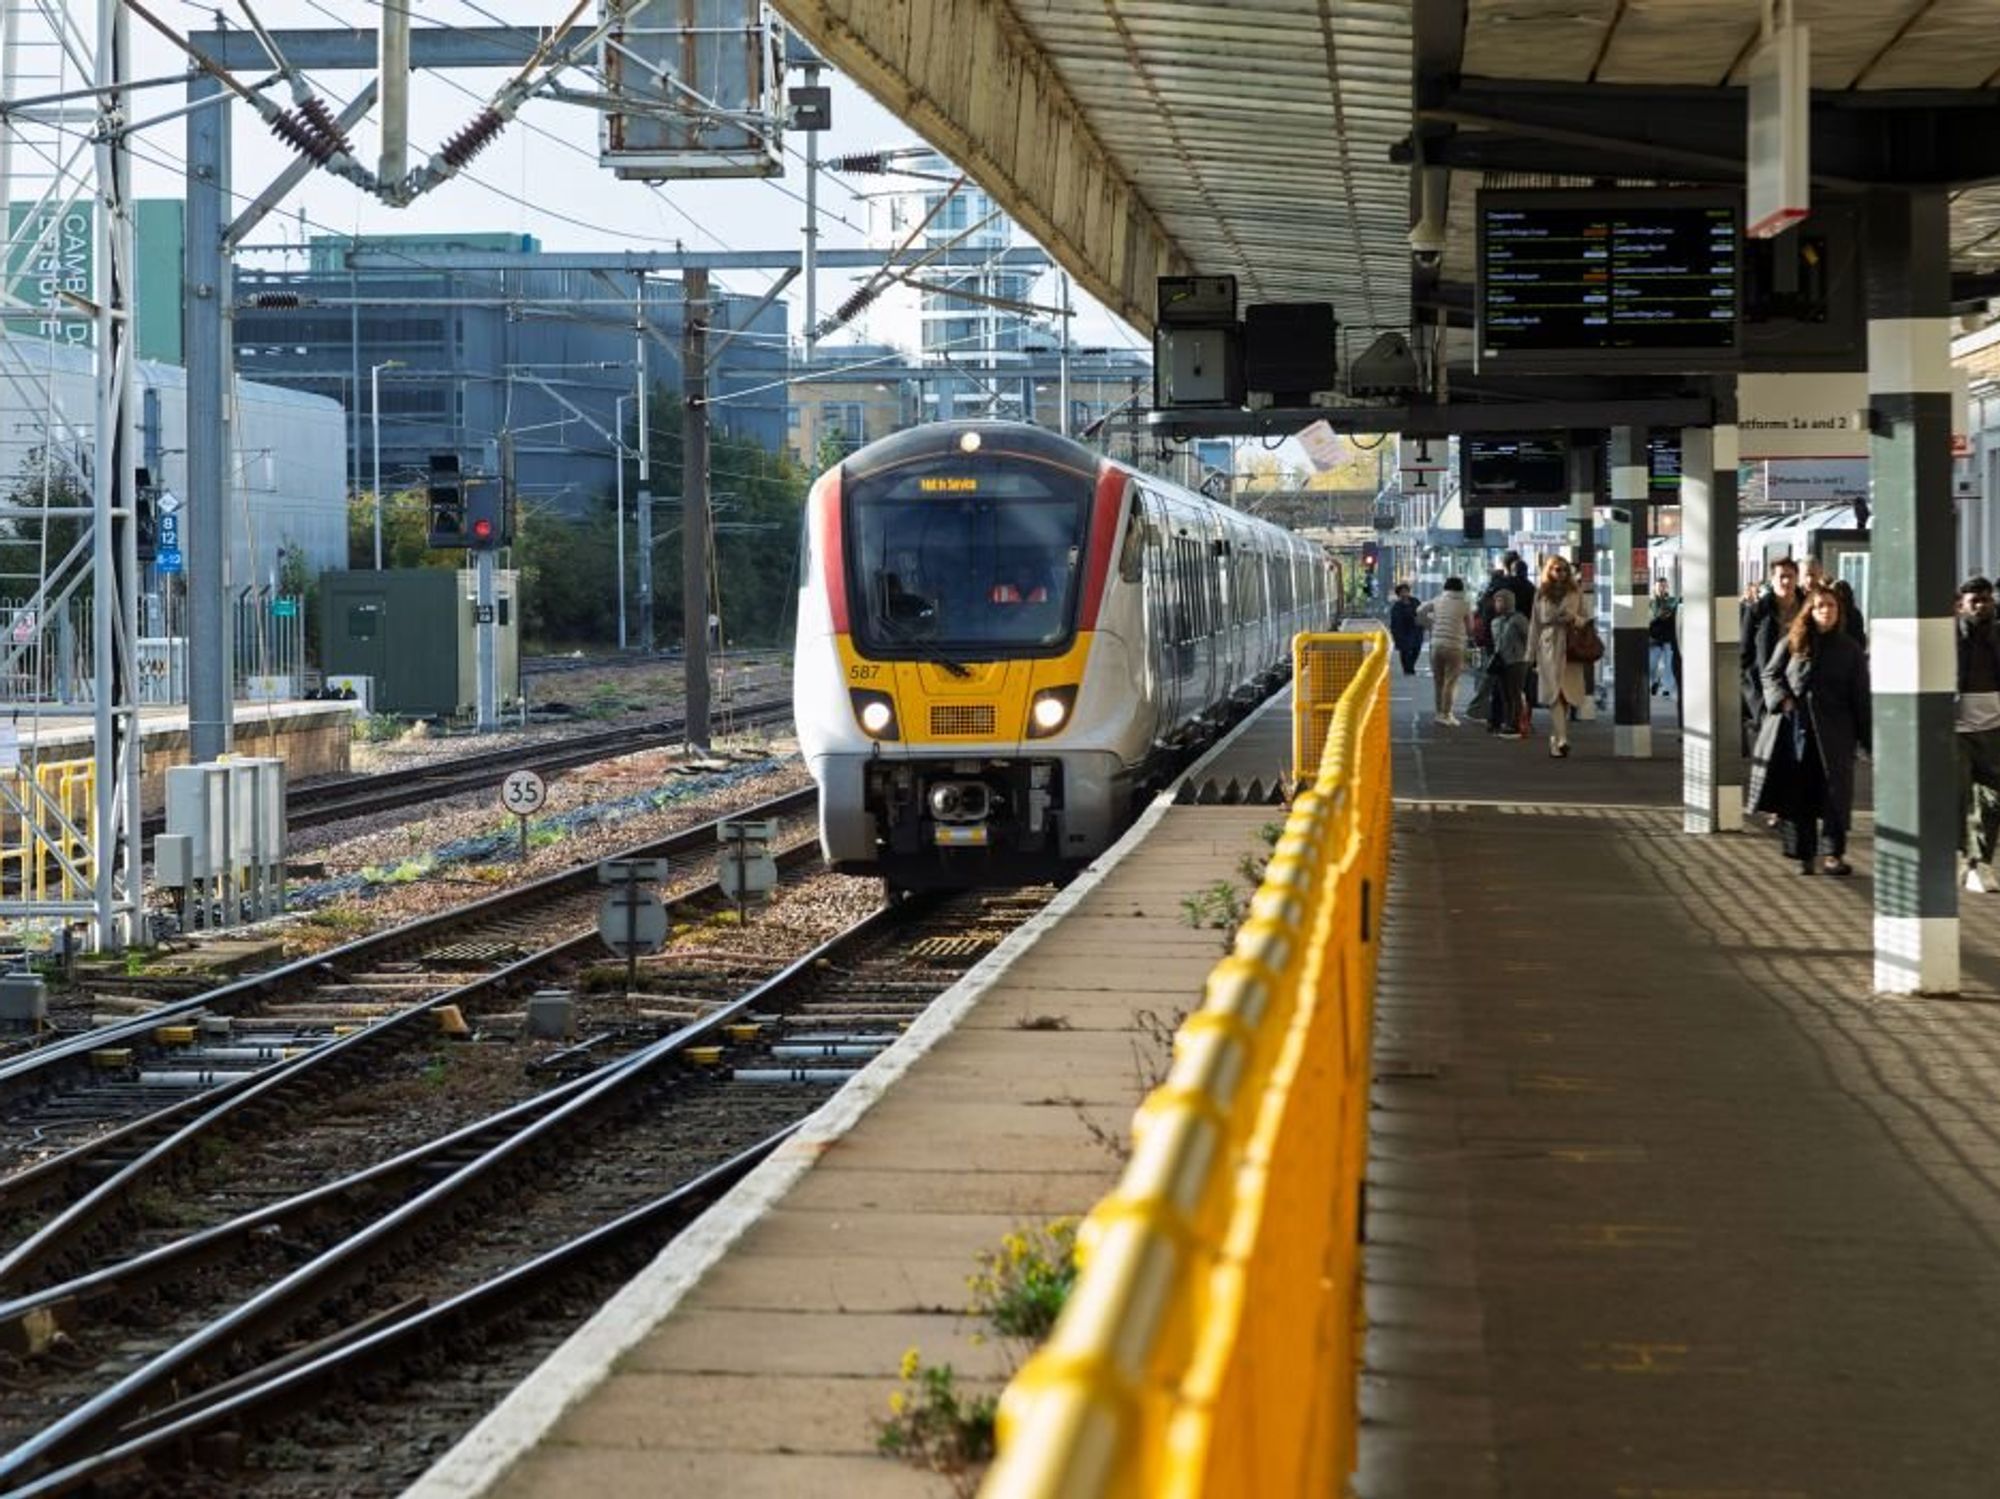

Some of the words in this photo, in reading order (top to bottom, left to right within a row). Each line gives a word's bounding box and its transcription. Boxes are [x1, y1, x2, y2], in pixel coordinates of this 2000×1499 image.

[64, 214, 87, 347] CAMBD
[1738, 418, 1788, 429] atforms
[1793, 417, 1808, 429] 1a
[1811, 418, 1835, 429] and
[1838, 417, 1847, 429] 2
[163, 517, 173, 530] 8
[162, 531, 175, 544] 12
[850, 665, 880, 679] 587
[510, 781, 537, 803] 35
